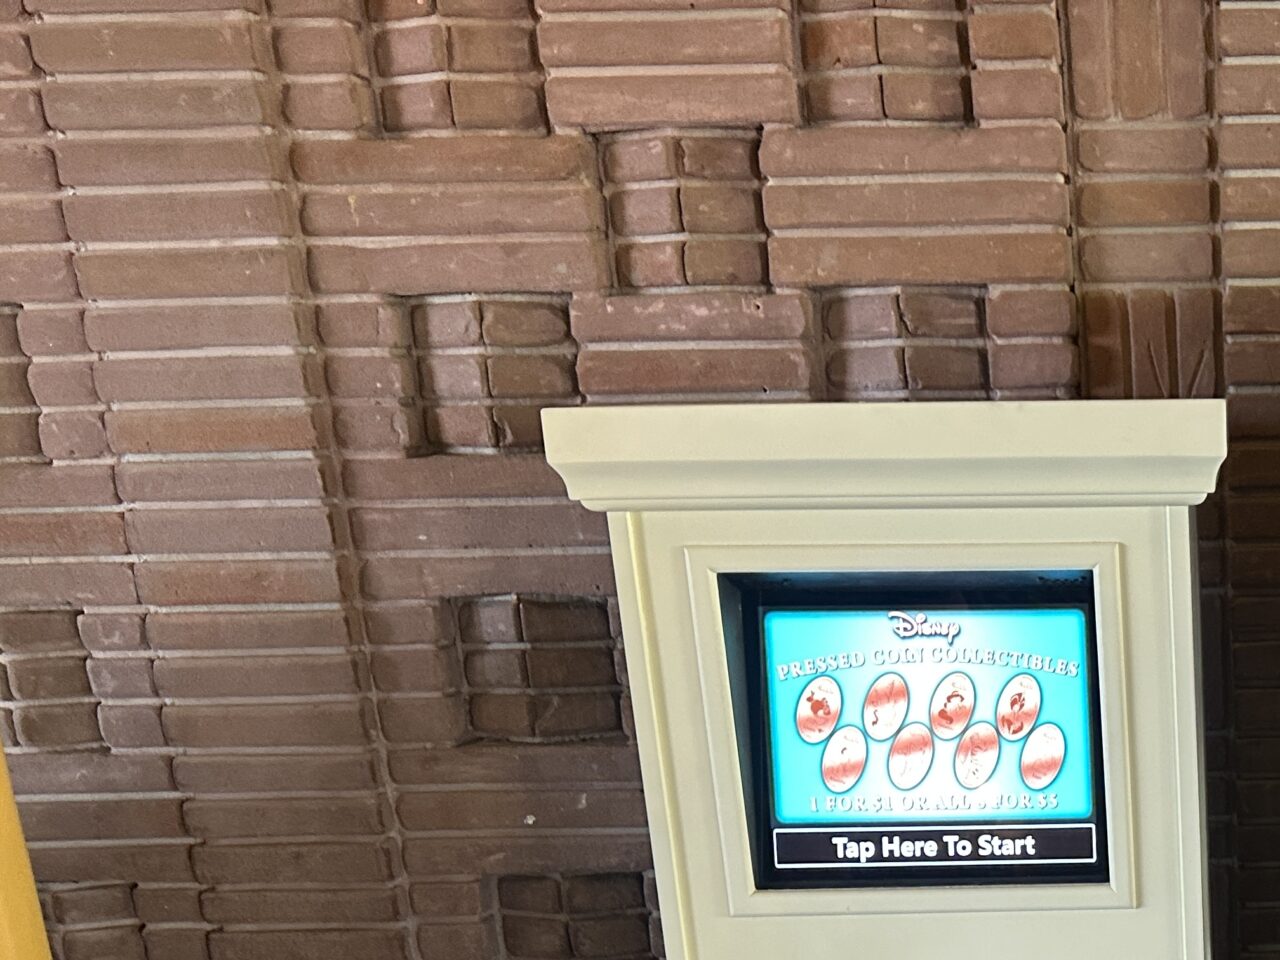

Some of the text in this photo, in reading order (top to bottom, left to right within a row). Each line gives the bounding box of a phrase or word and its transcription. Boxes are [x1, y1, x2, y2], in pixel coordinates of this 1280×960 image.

[887, 610, 961, 646] Disney
[776, 648, 1080, 681] PRESSED COIN COLLECTIBLES
[825, 796, 869, 812] FOR
[902, 795, 930, 812] OR
[831, 834, 1036, 863] Tap Here To Start
